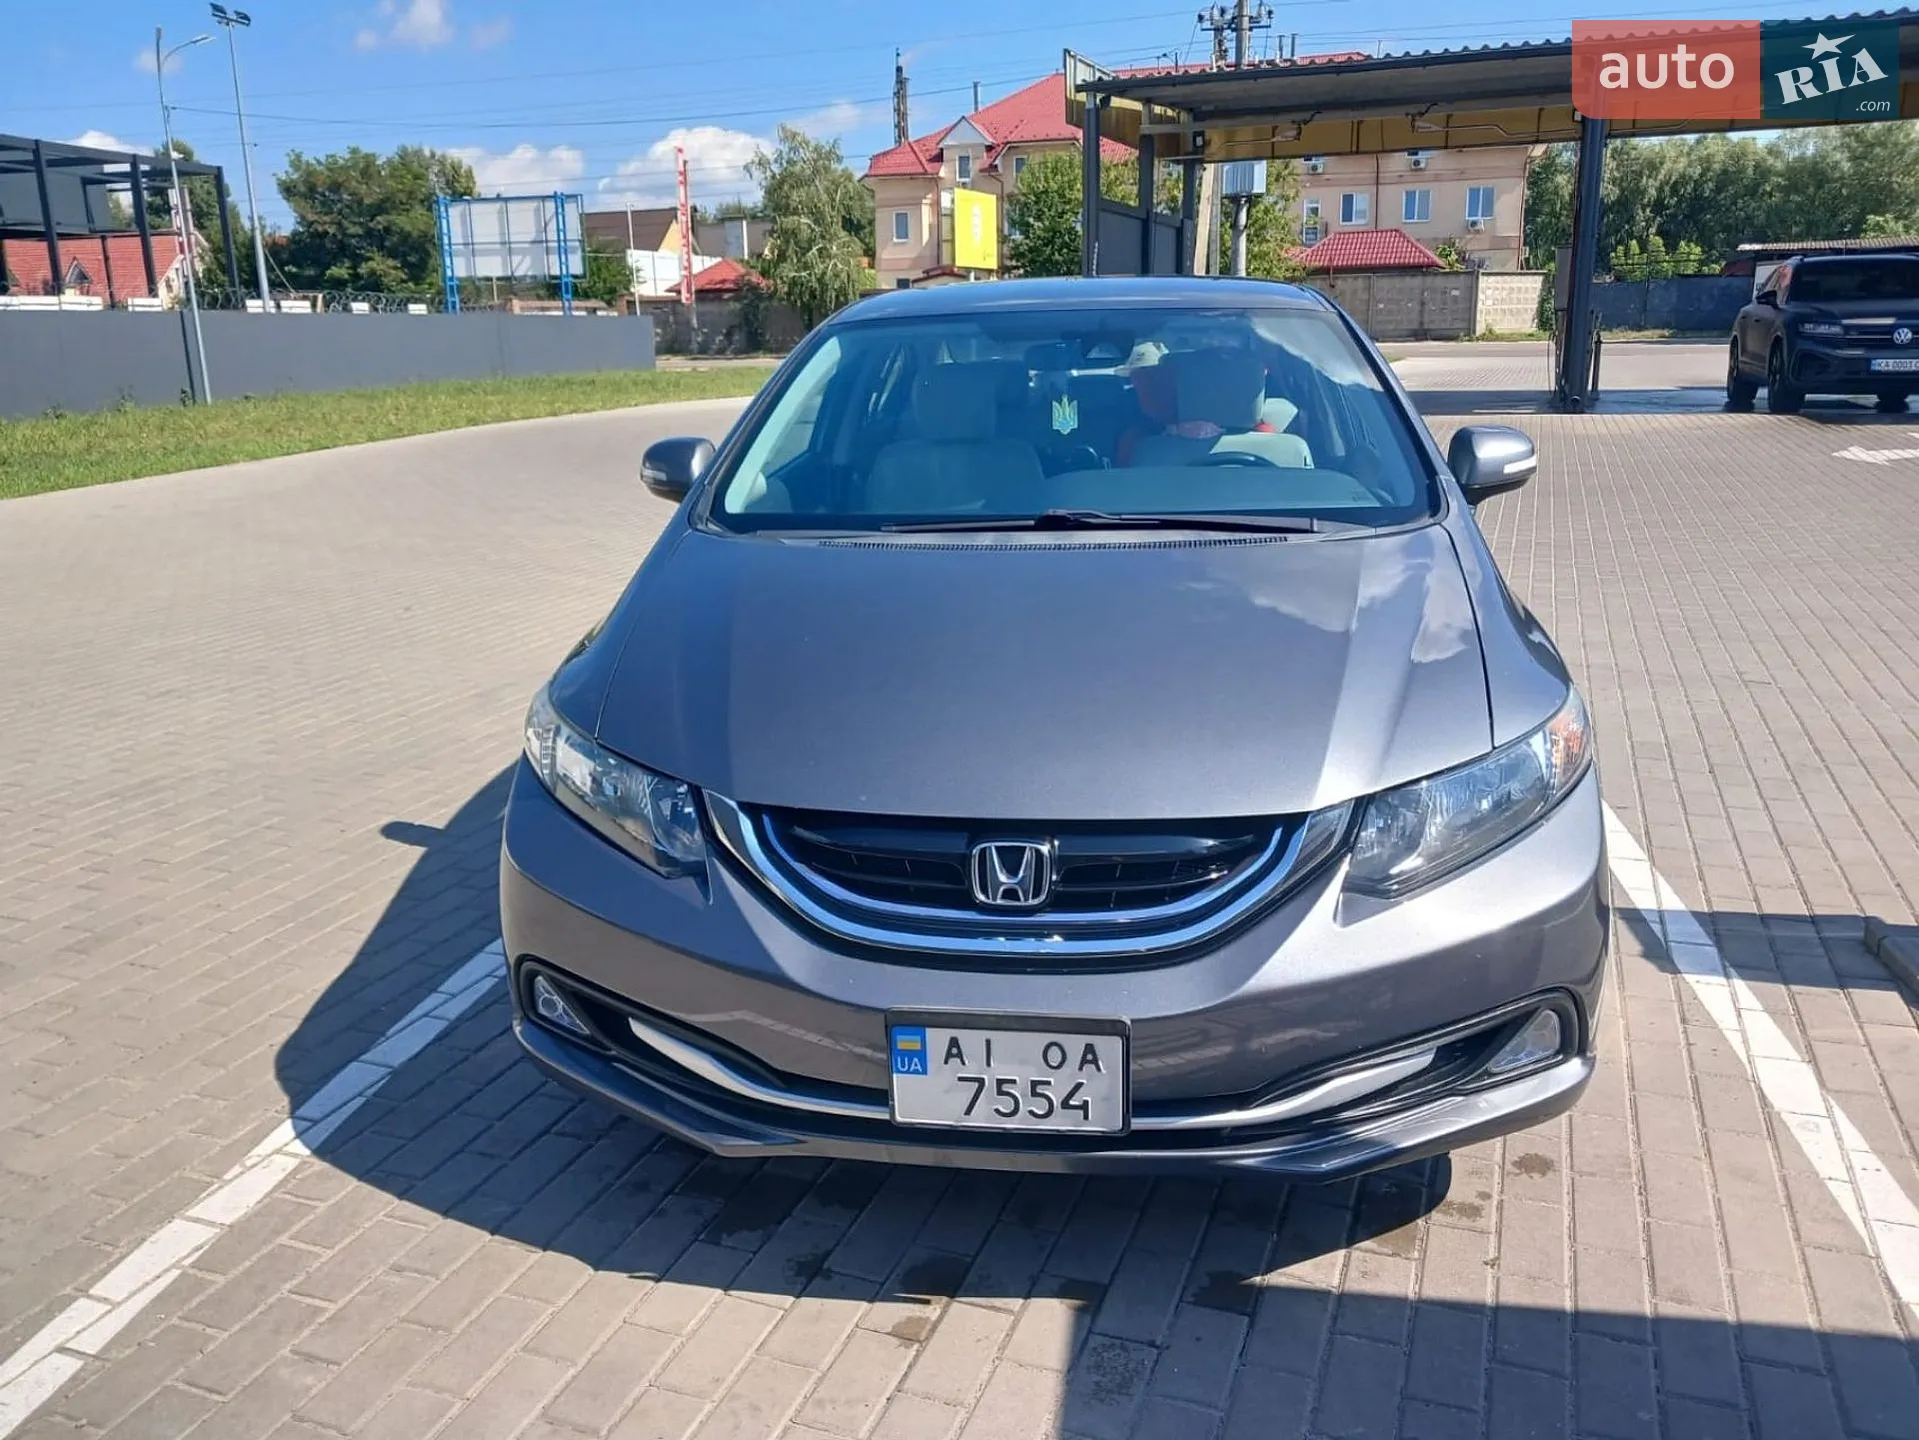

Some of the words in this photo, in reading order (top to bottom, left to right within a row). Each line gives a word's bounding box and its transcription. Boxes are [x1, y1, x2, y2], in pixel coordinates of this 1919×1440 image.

[897, 1055, 922, 1072] UA
[943, 1036, 992, 1067] AI
[1042, 1041, 1104, 1073] OA
[957, 1075, 1090, 1121] 7554
